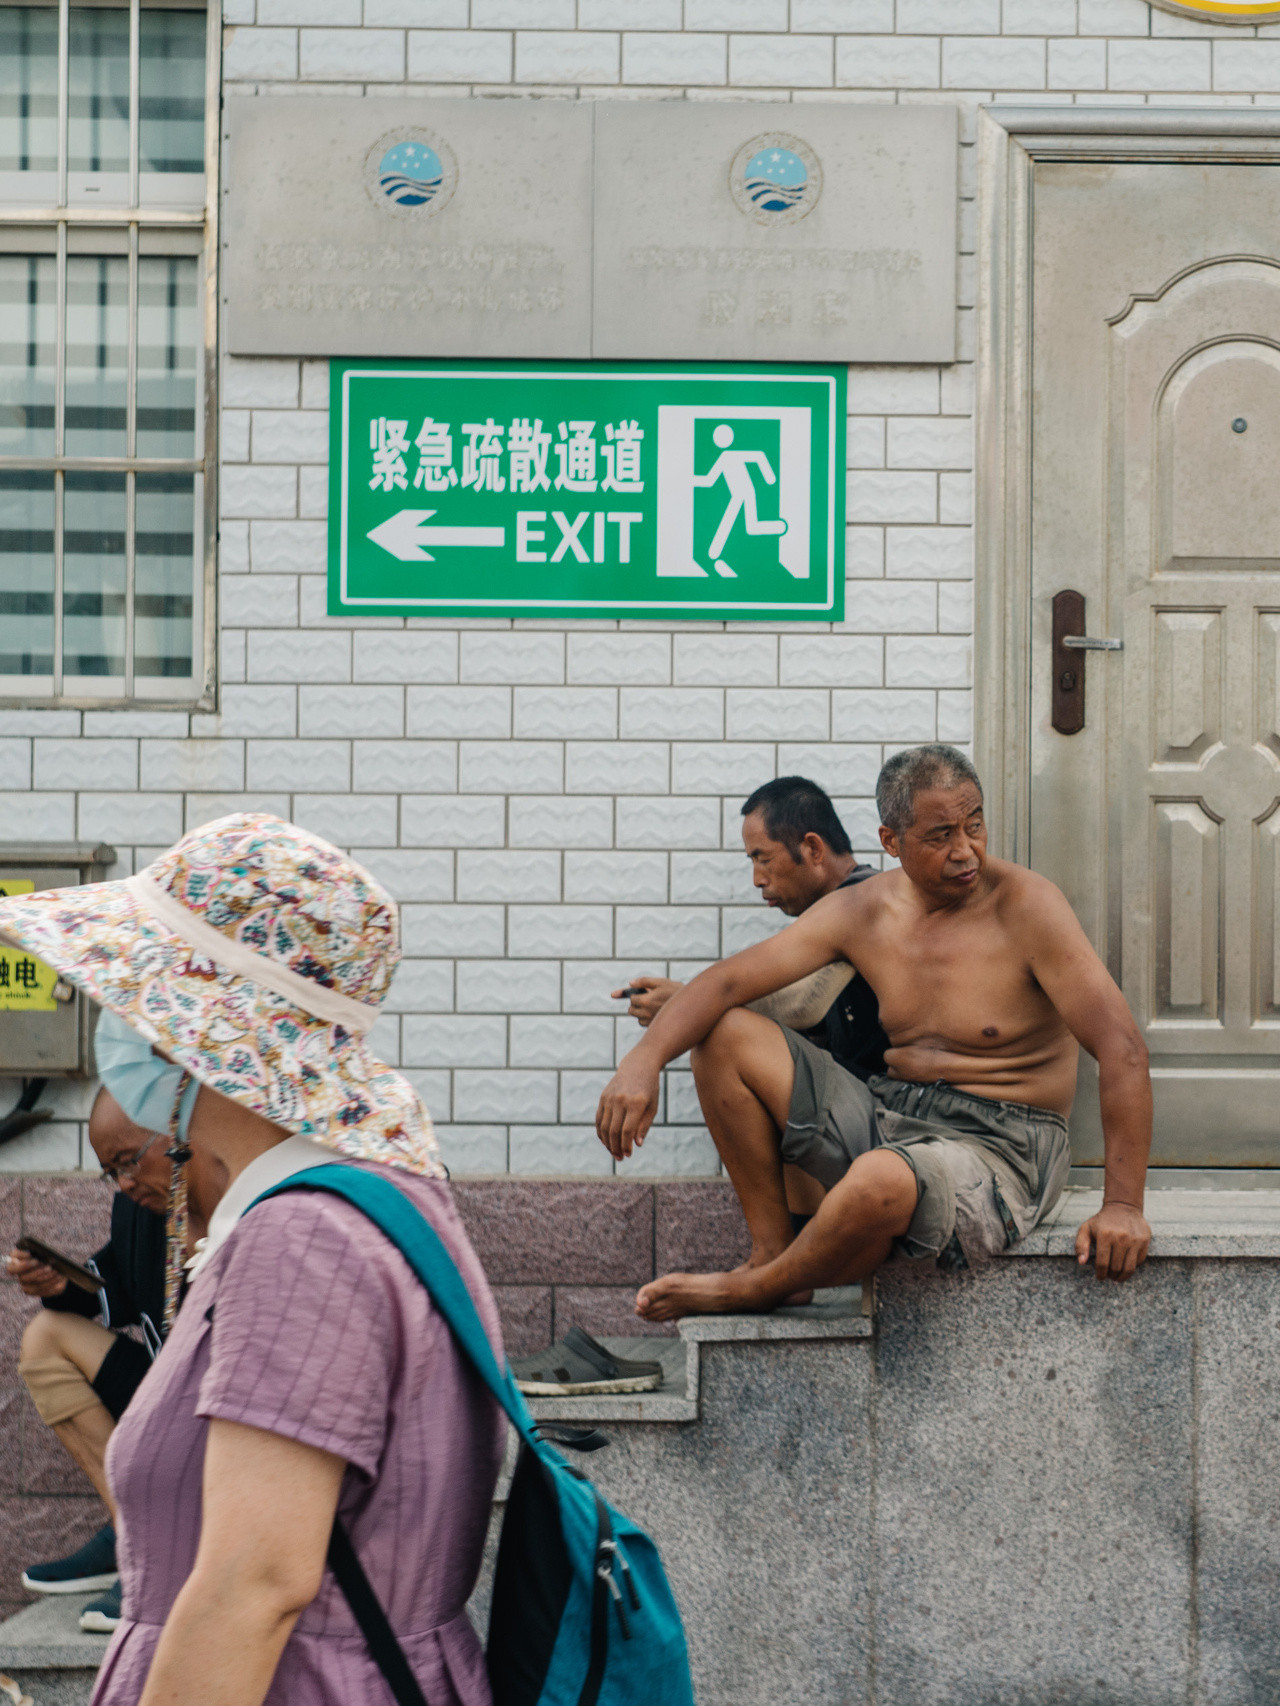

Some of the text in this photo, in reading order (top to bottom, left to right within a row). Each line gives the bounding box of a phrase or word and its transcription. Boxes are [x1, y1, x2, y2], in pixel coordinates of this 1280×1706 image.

[368, 416, 645, 493] 紧急疏散通道
[515, 510, 644, 564] EXIT
